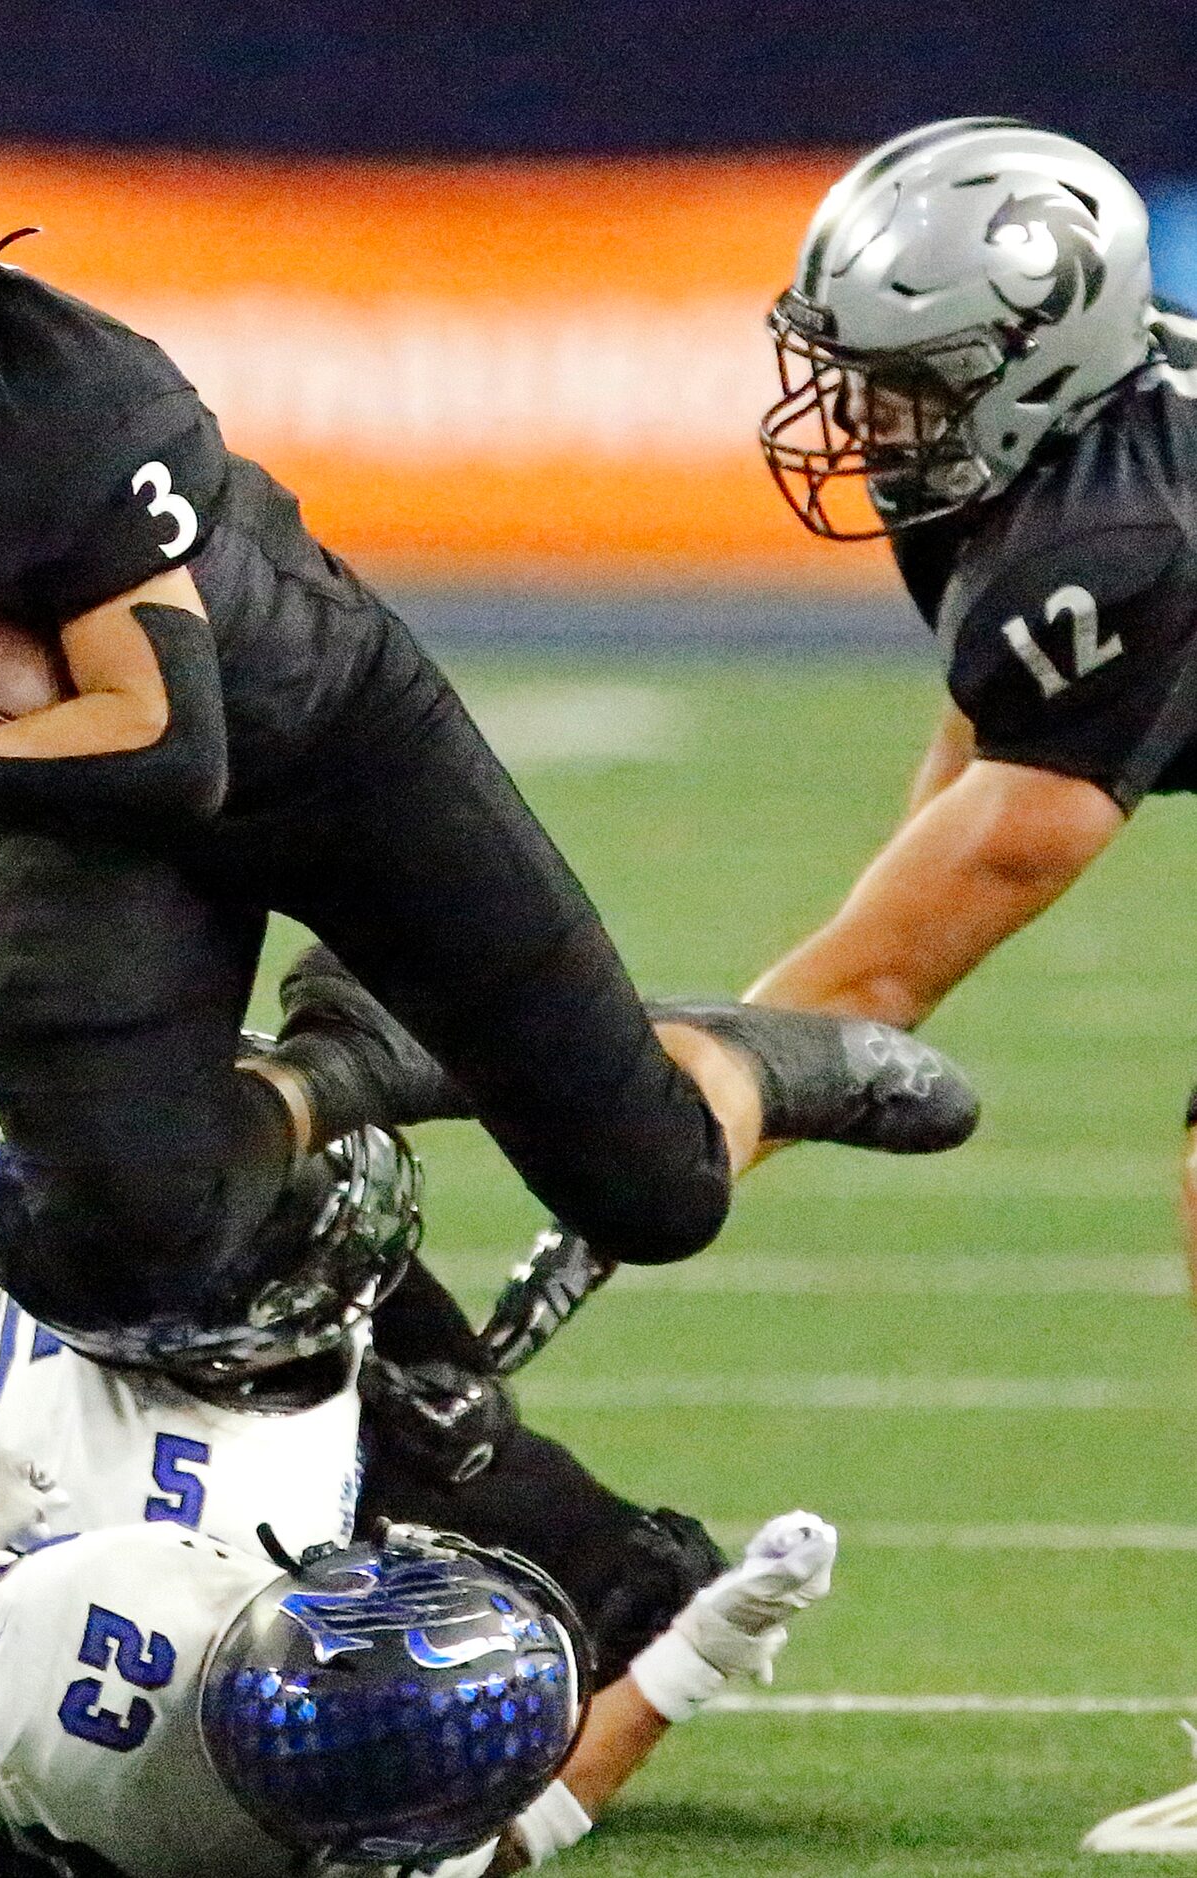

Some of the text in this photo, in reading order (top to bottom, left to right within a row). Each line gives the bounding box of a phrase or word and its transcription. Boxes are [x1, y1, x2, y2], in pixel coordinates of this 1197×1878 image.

[131, 461, 198, 559] 3
[1002, 585, 1124, 698] 12
[144, 1432, 211, 1532] 5
[57, 1603, 176, 1752] 23
